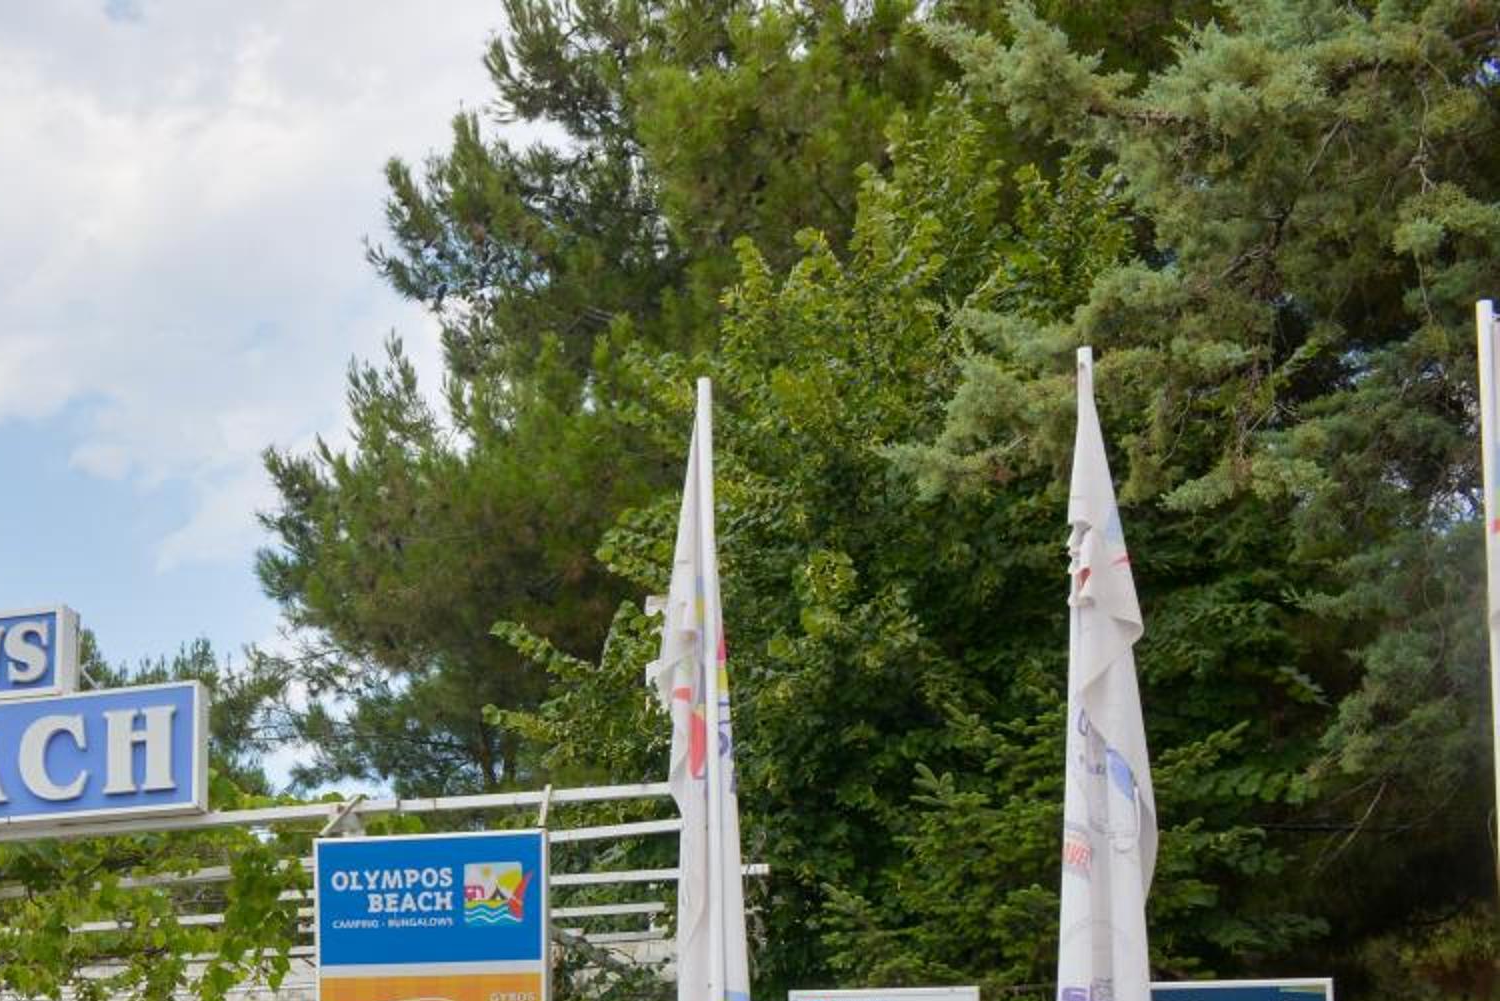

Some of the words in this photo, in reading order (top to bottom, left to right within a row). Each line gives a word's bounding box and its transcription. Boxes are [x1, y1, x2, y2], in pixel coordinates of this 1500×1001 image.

[331, 867, 453, 891] OLYMPOS
[367, 892, 453, 913] BEACH
[332, 918, 379, 930] CAMPING
[388, 917, 454, 928] BUNGALOWS
